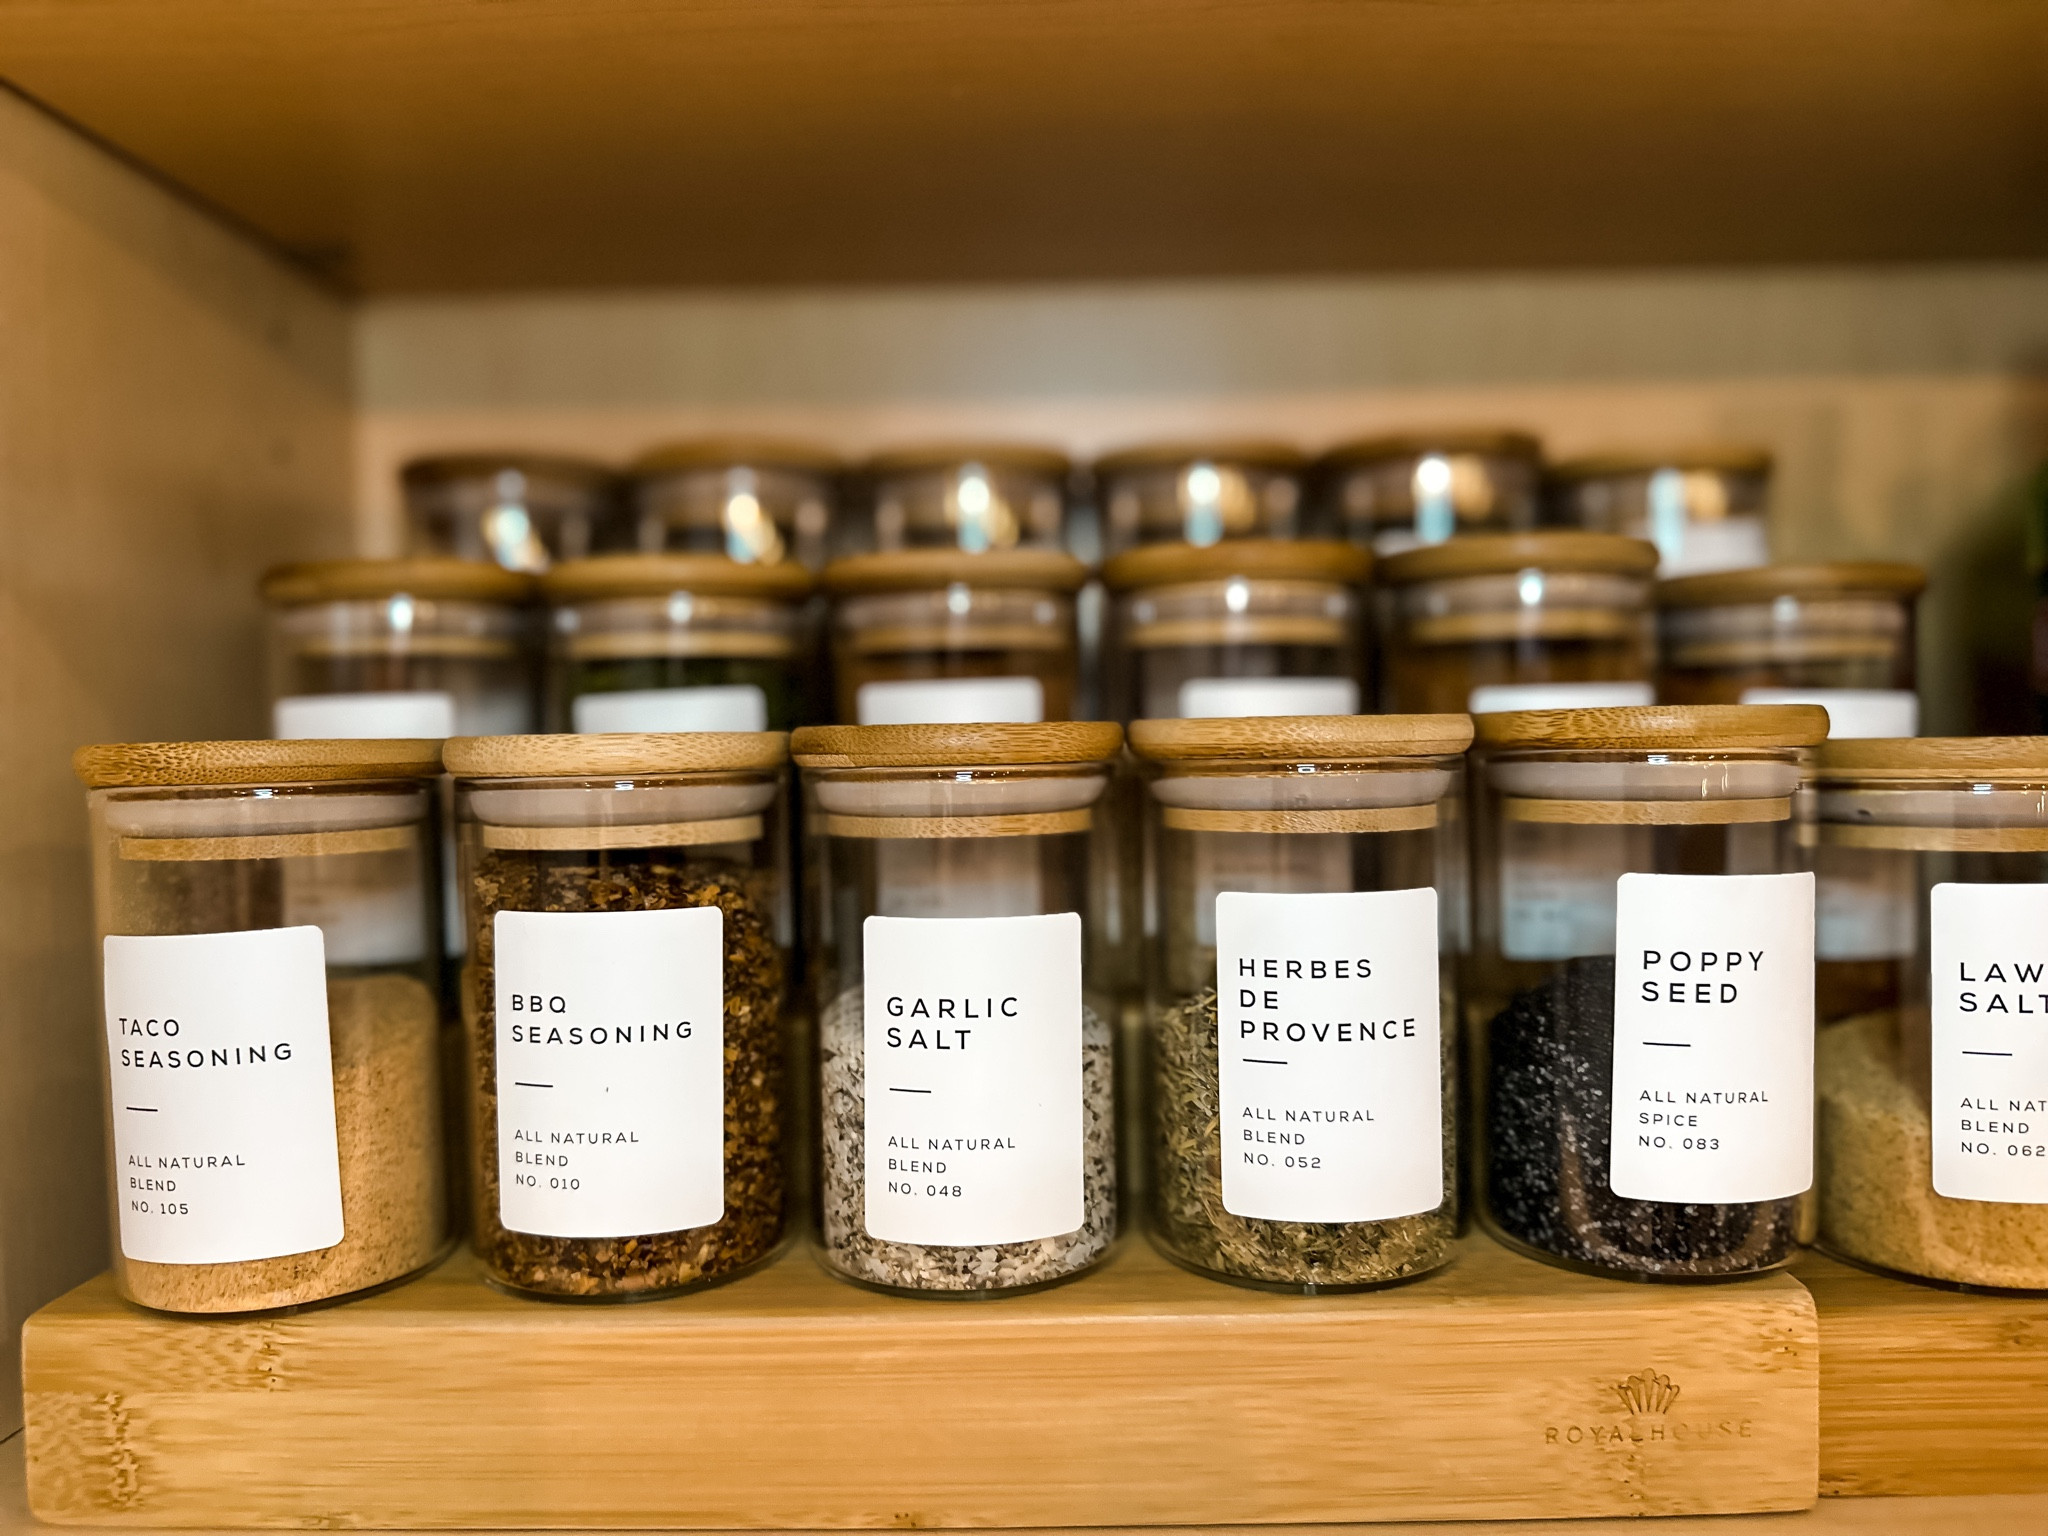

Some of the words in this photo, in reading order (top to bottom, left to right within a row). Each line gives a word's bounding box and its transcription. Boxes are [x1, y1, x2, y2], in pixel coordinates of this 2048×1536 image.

[1240, 958, 1371, 978] HERBES
[1644, 950, 1763, 971] POPPY
[1240, 989, 1278, 1009] DE
[1642, 981, 1737, 1003] SEED
[512, 994, 565, 1013] BBQ
[887, 997, 1017, 1018] GARLIC
[1960, 992, 2048, 1013] SALT
[119, 1018, 179, 1036] TACO
[512, 1022, 691, 1045] SEASONING
[1241, 1018, 1415, 1042] PROVENCE
[887, 1027, 971, 1049] SALT
[122, 1043, 291, 1068] SEASONING
[1640, 1090, 1675, 1103] ALL
[1686, 1091, 1768, 1104] NATURAL
[1961, 1098, 1998, 1110] ALL
[1243, 1107, 1276, 1120] ALL
[1286, 1110, 1374, 1122] NATURAL
[1639, 1113, 1697, 1127] SPICE
[1962, 1120, 2029, 1133] BLEND
[515, 1129, 542, 1142] ALL
[551, 1132, 638, 1144] NATURAL
[888, 1136, 919, 1149] ALL
[929, 1138, 1015, 1150] NATURAL
[1244, 1129, 1305, 1145] BLEND
[1639, 1136, 1671, 1148] NO.
[1683, 1138, 1719, 1150] 083
[1962, 1142, 1996, 1155] NO.
[2008, 1145, 2045, 1156] 062
[129, 1155, 151, 1168] ALL
[159, 1155, 245, 1169] NATURAL
[516, 1151, 568, 1166] BLEND
[889, 1159, 946, 1173] BLEND
[1244, 1152, 1274, 1166] NO.
[1285, 1156, 1320, 1168] 052
[130, 1177, 176, 1191] BLEND
[516, 1174, 541, 1187] NO.
[550, 1178, 579, 1190] 010
[889, 1181, 916, 1195] NO.
[927, 1185, 961, 1197] 048
[132, 1200, 153, 1213] NO.
[161, 1203, 188, 1214] 105
